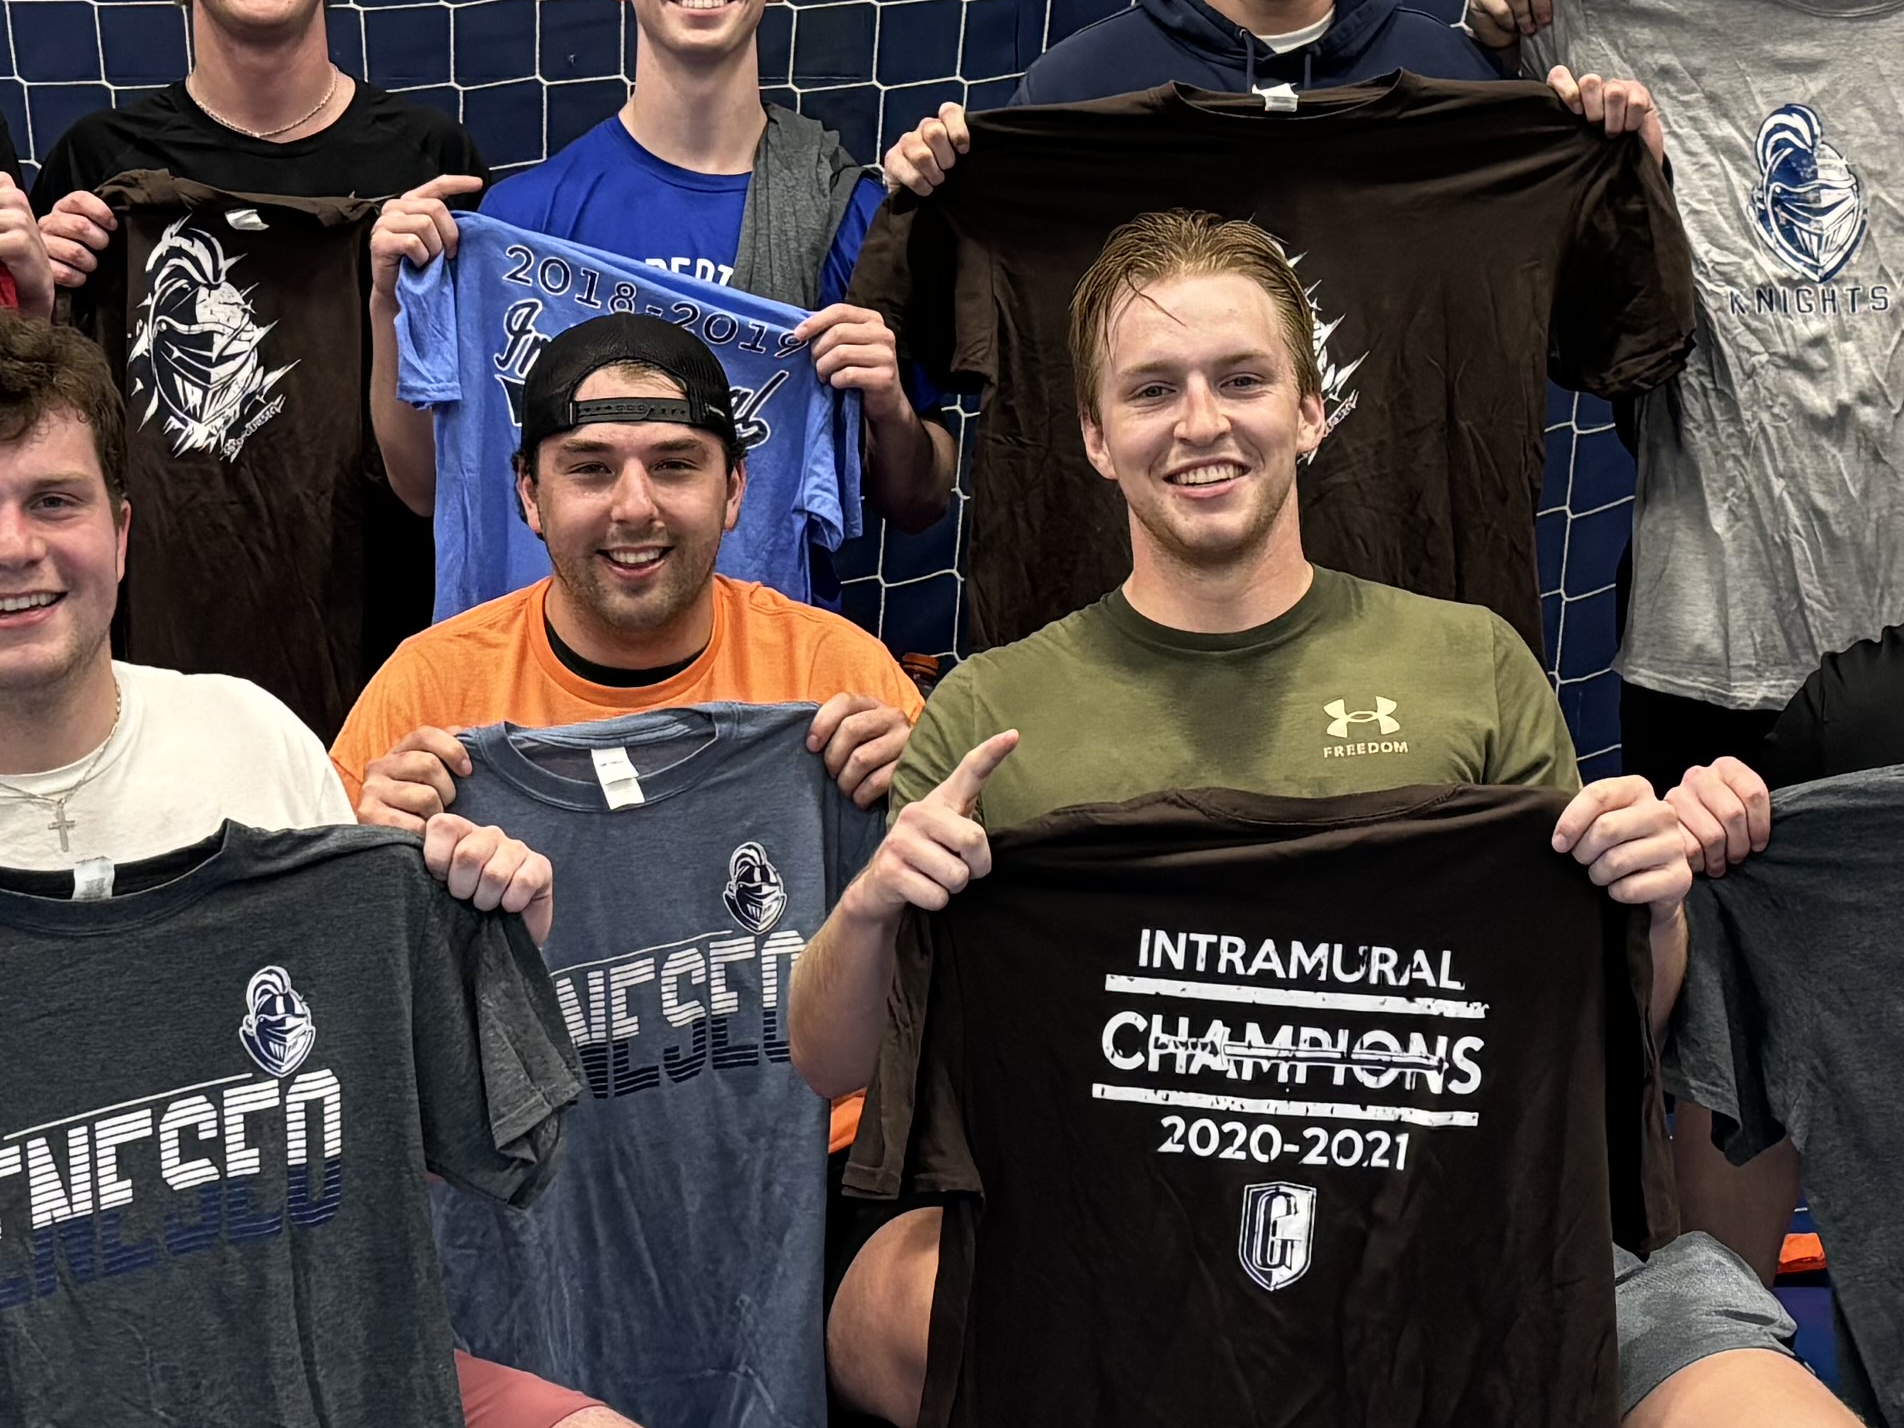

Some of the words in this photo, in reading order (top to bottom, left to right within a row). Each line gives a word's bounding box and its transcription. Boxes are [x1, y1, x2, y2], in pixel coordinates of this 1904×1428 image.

[501, 243, 810, 359] 2018-2019
[1728, 284, 1890, 316] KNIGHTS
[1323, 740, 1409, 759] FREEDOM
[1138, 927, 1466, 992] INTRAMURAL
[1101, 1010, 1486, 1096] CHAMPIONS
[1157, 1114, 1410, 1171] 2020-2021
